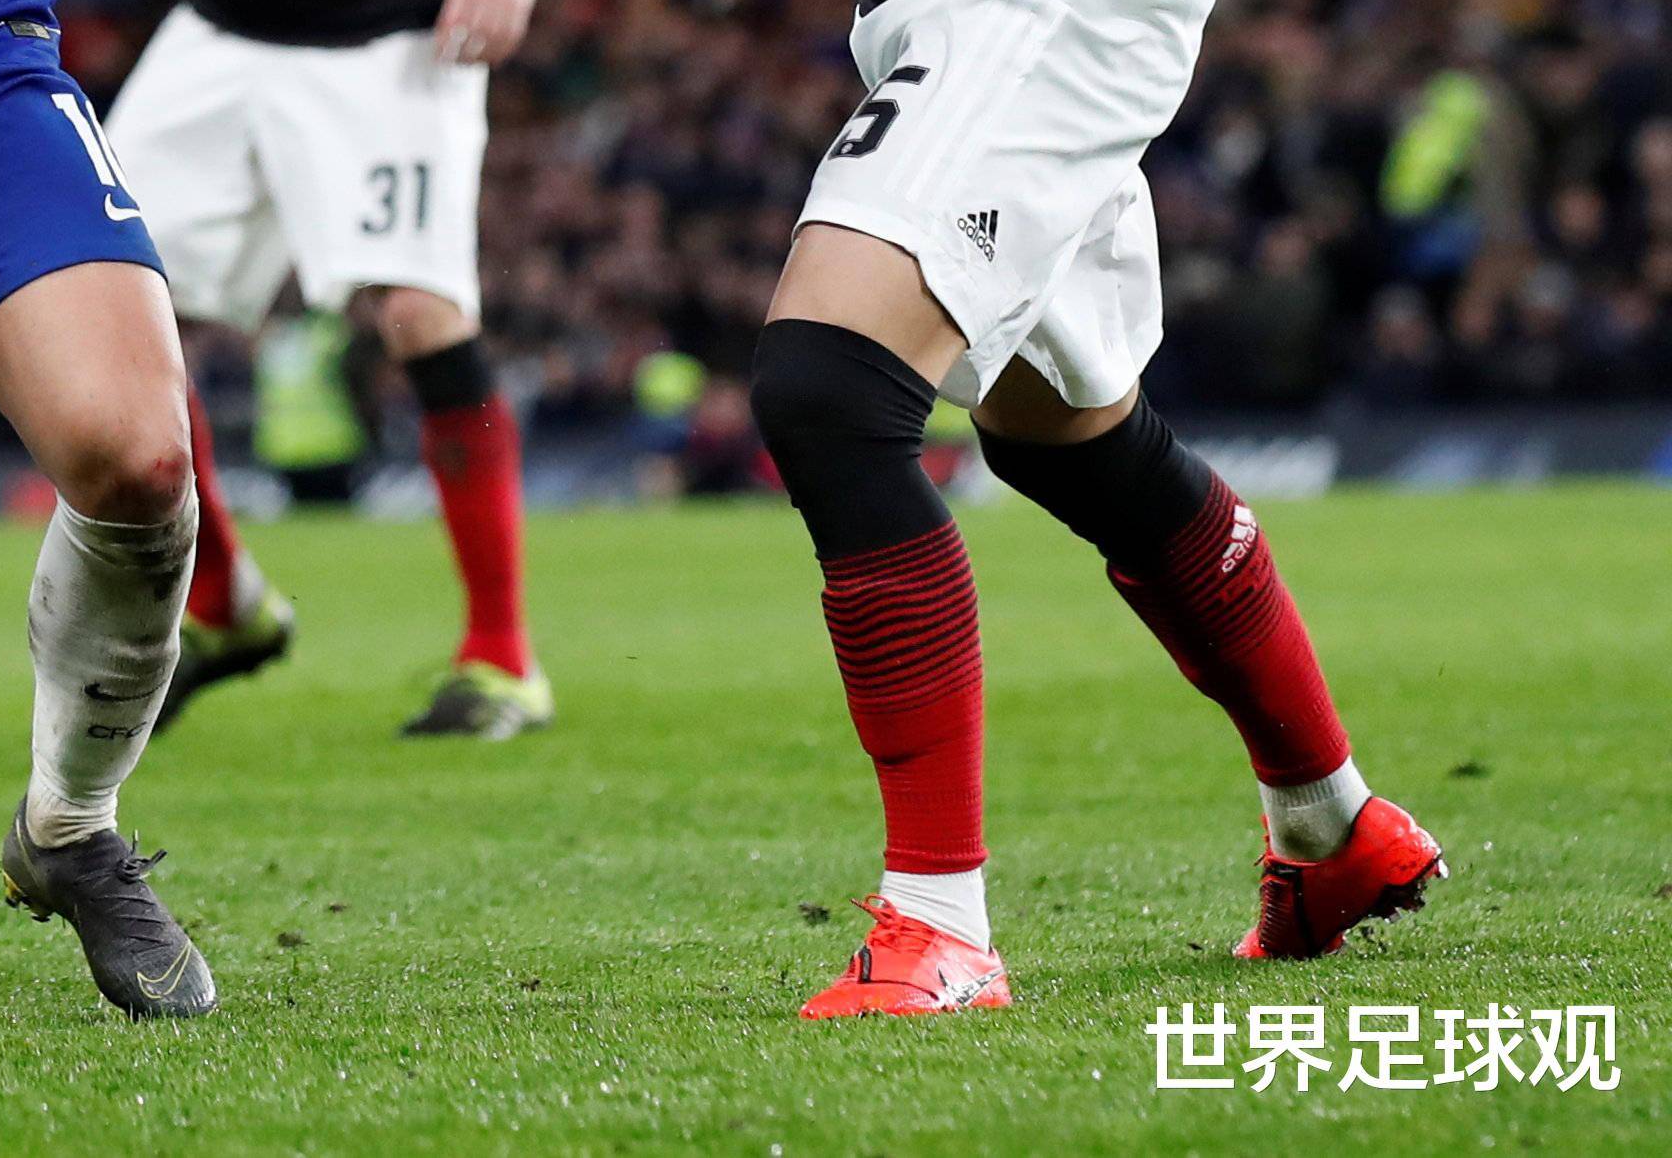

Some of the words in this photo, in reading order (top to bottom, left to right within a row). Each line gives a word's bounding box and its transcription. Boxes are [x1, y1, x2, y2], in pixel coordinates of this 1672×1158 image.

[360, 162, 429, 236] 31
[957, 217, 996, 263] adidas
[87, 721, 148, 740] CFC
